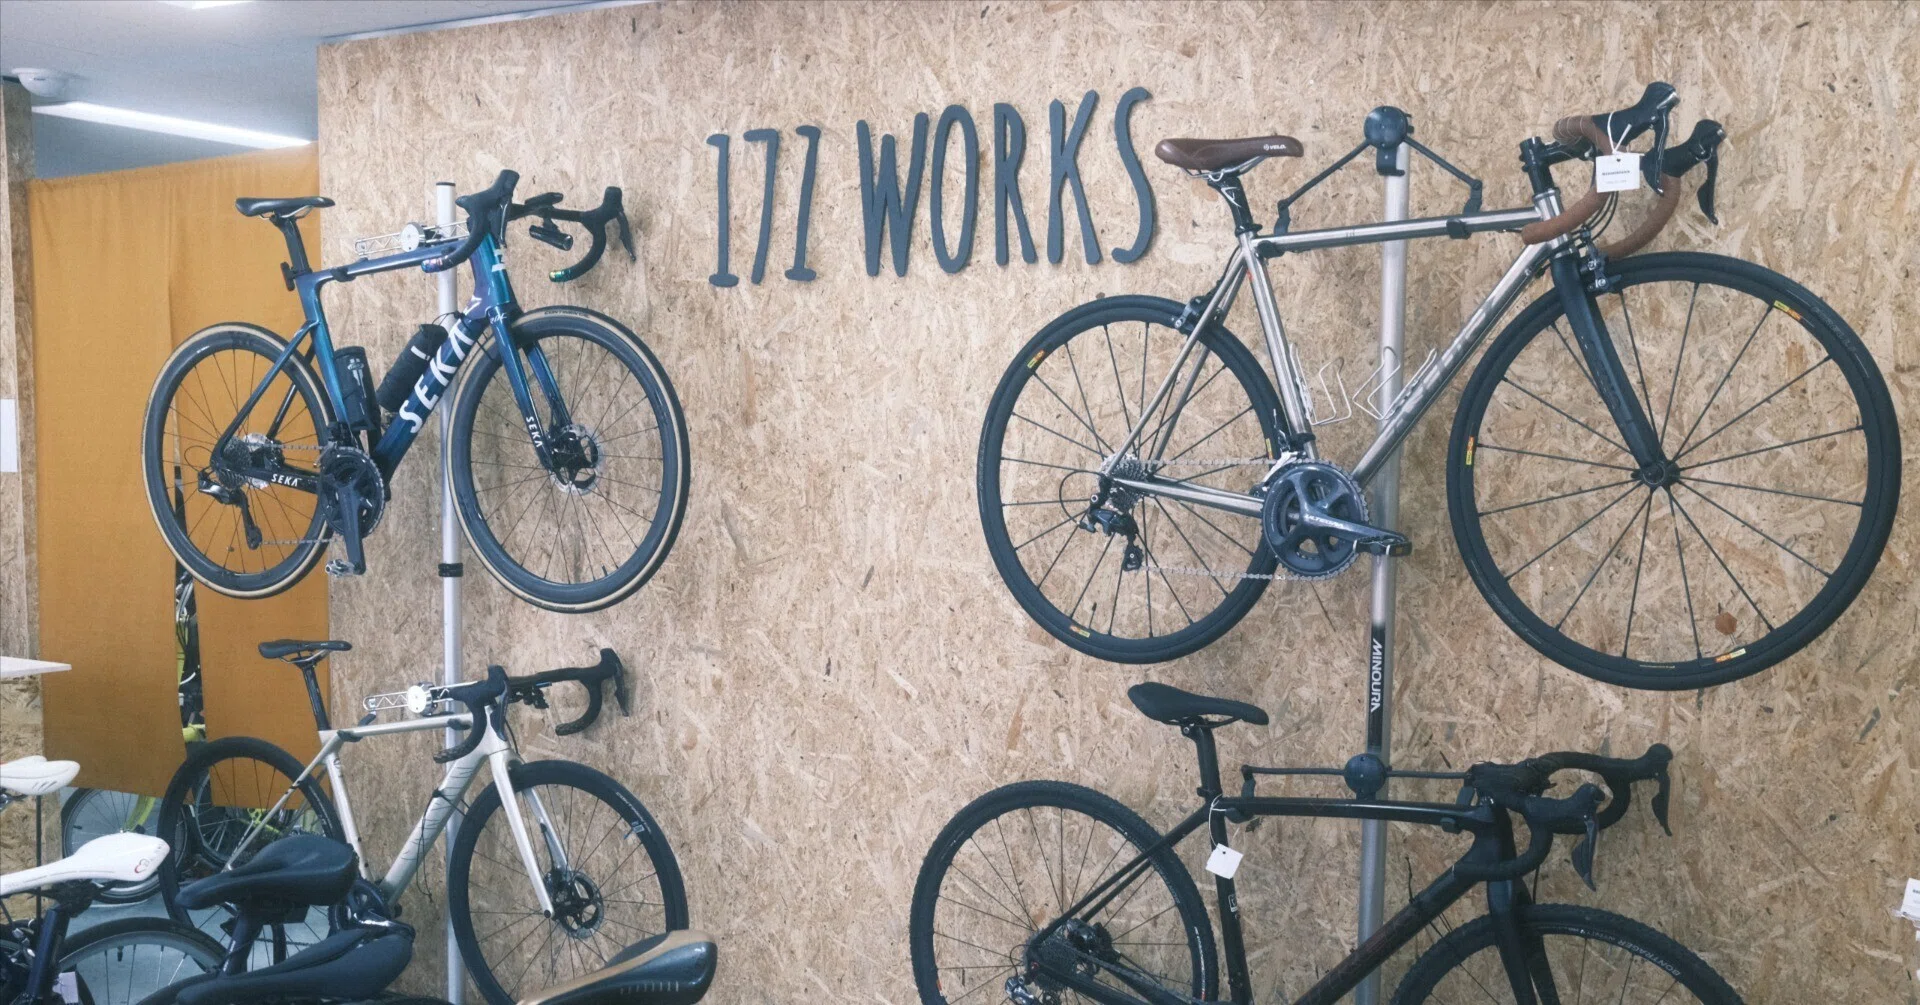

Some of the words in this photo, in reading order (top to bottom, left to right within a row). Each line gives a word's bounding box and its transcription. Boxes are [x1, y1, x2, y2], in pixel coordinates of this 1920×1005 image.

[856, 86, 1158, 278] WORKS
[399, 318, 476, 434] SEKA
[526, 416, 543, 448] SEKA
[271, 473, 299, 487] SEKA
[1371, 638, 1383, 713] MINOURA
[1617, 939, 1681, 977] BONTRAGER
